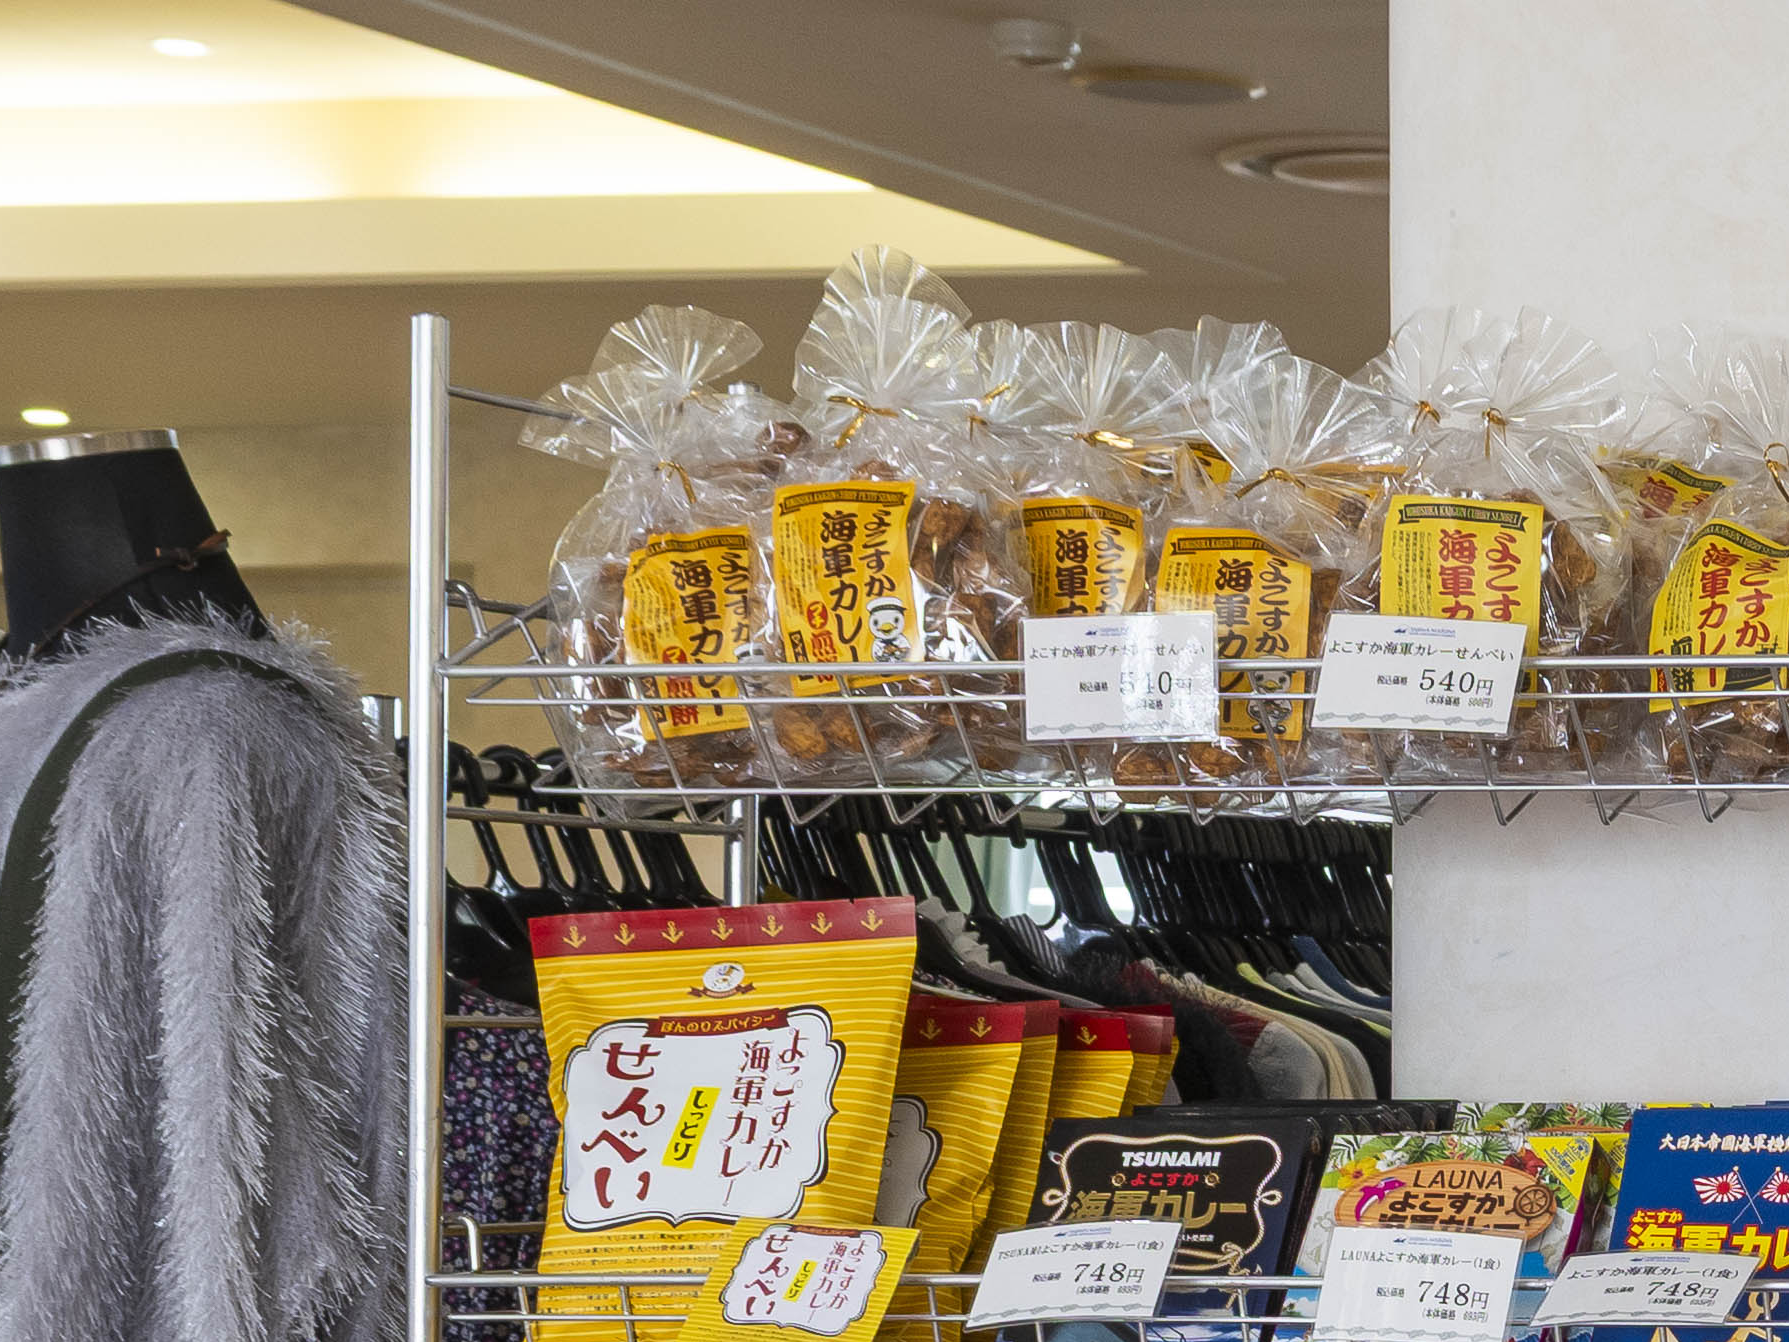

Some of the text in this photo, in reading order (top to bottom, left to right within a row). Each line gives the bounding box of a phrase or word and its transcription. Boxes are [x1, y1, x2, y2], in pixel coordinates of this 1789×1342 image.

[860, 509, 897, 597] よこすか
[820, 510, 863, 664] 海軍カレー
[1735, 556, 1789, 649] よこすか
[1327, 639, 1515, 663] よこすか海軍カレーせんべい
[1419, 669, 1493, 696] 540円
[661, 1012, 777, 1034] ほんのりスパイシー
[759, 1026, 803, 1173] よこすか
[582, 1041, 666, 1209] せんべい
[673, 1088, 709, 1162] しっとり
[720, 1039, 770, 1206] 海軍カレー
[1121, 1150, 1221, 1168] TSUNAMI
[1130, 1172, 1199, 1188] よこすか
[1412, 1168, 1504, 1190] LAUNA
[1070, 1189, 1247, 1229] 海軍カレー
[1388, 1191, 1504, 1215] よこすか
[1631, 1208, 1683, 1225] よこすか
[1074, 1262, 1145, 1285] 748円
[1418, 1281, 1489, 1309] 748円
[1646, 1281, 1719, 1299] 748円
